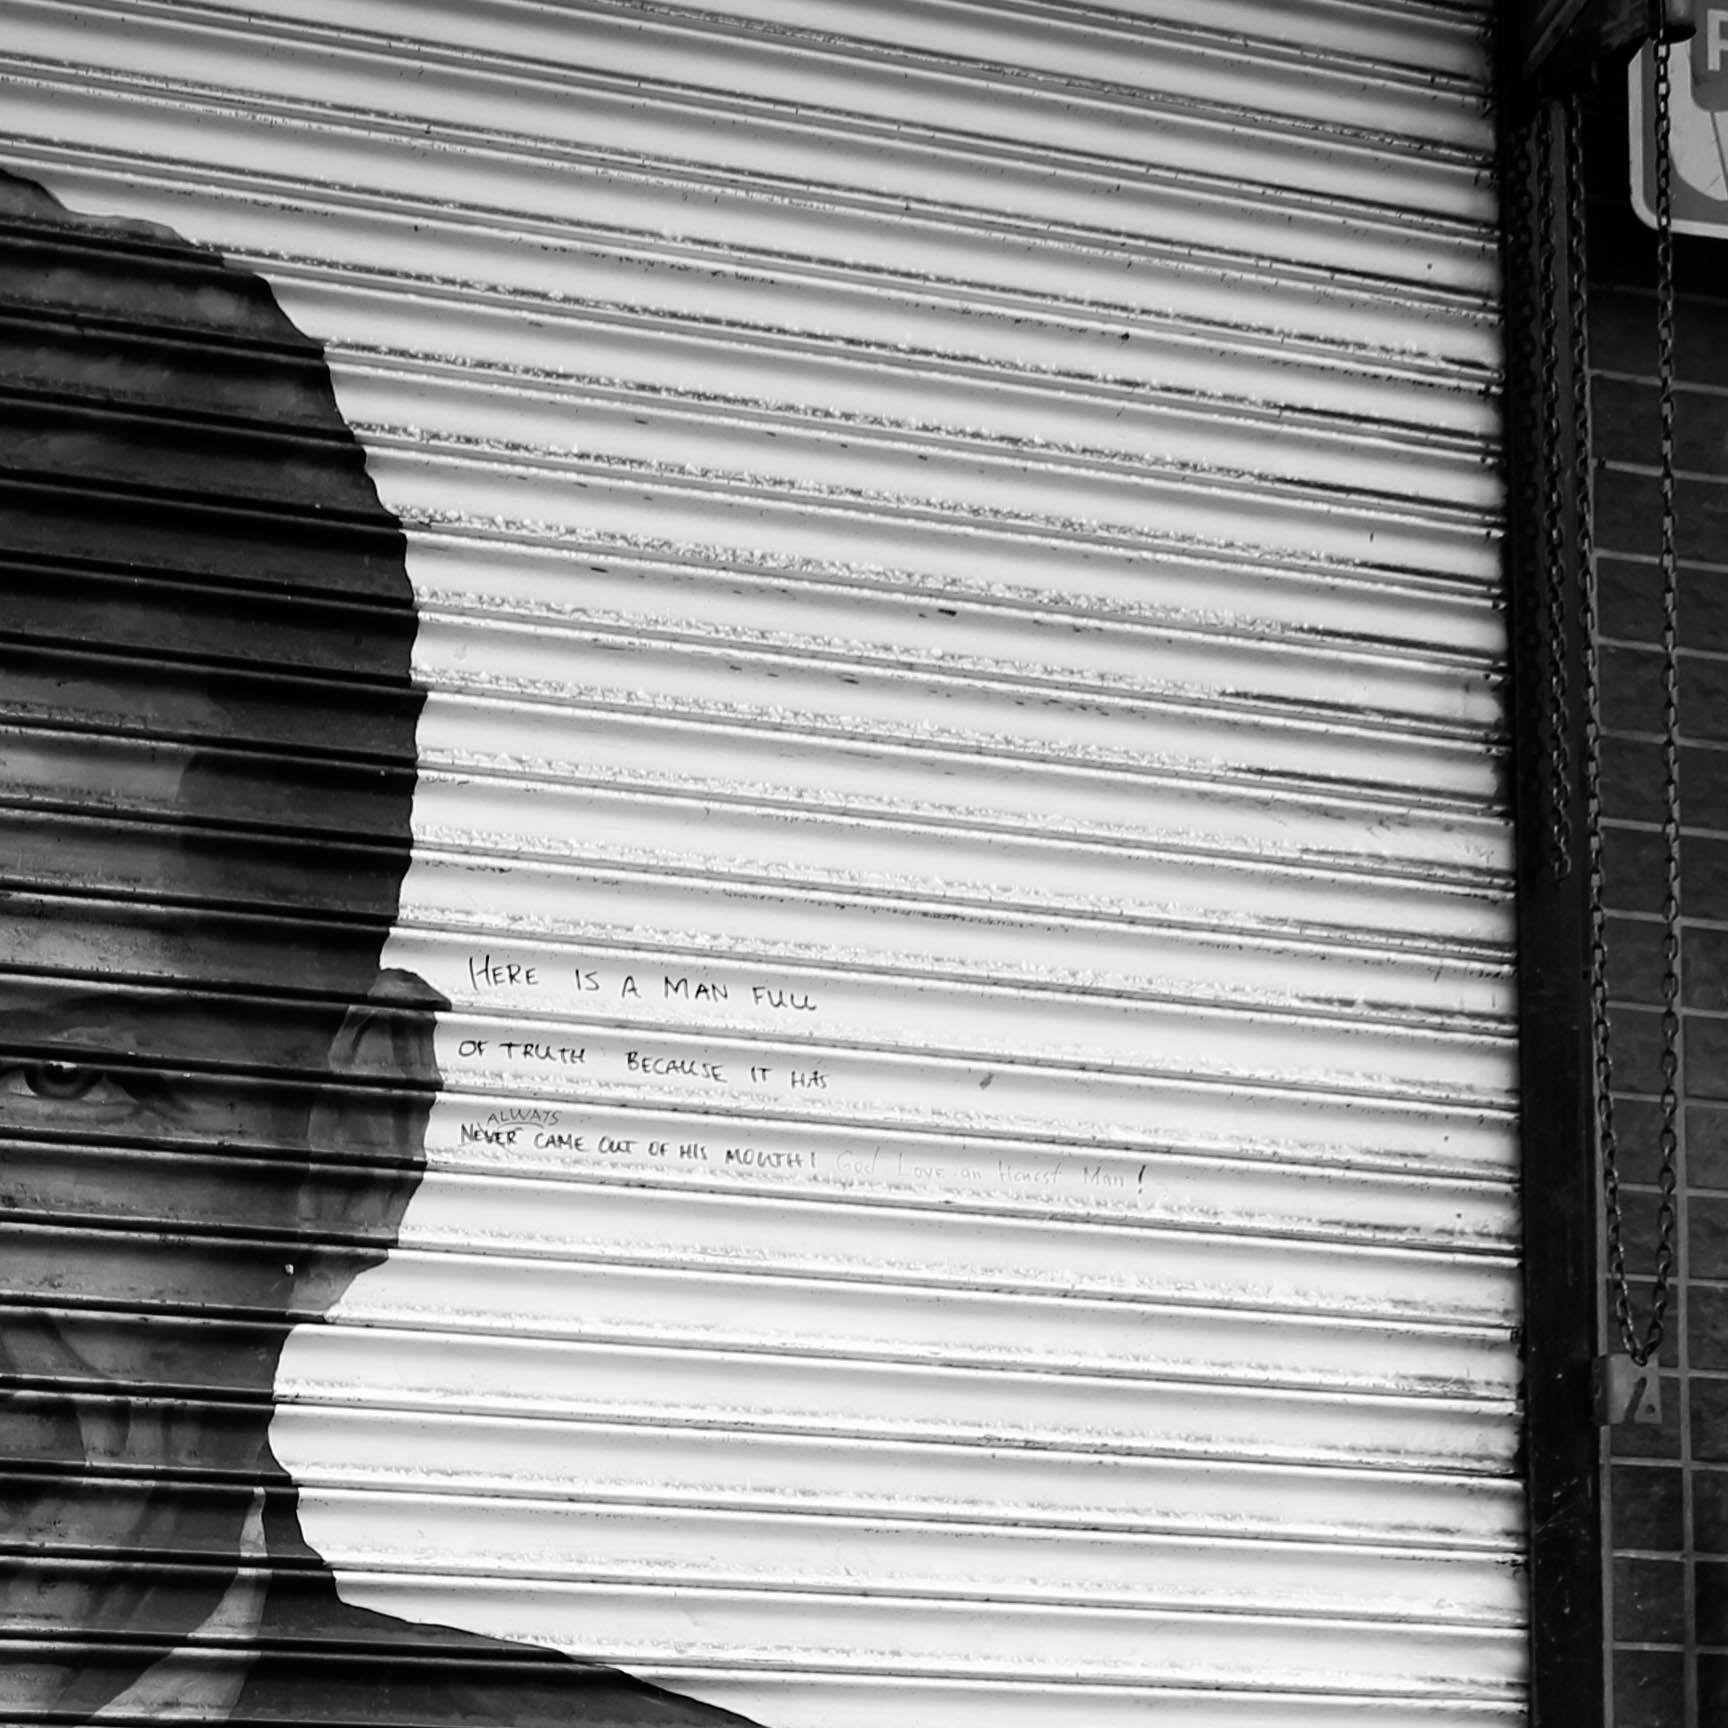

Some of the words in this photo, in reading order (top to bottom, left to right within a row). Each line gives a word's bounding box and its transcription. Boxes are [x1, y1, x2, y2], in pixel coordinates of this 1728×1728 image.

[469, 954, 540, 991] HERE
[575, 968, 600, 992] IS
[621, 975, 641, 999] A
[664, 976, 729, 1002] MAN
[458, 1039, 489, 1057] OF
[499, 1042, 586, 1064] TRUTH
[626, 1051, 728, 1083] BECAUSE
[750, 1066, 773, 1083] IT
[791, 1070, 831, 1090] HAS
[460, 1122, 516, 1146] NEVER
[534, 1132, 585, 1153] CAME
[598, 1136, 639, 1154] OUT
[648, 1140, 669, 1157] OF
[679, 1143, 708, 1160] HIS
